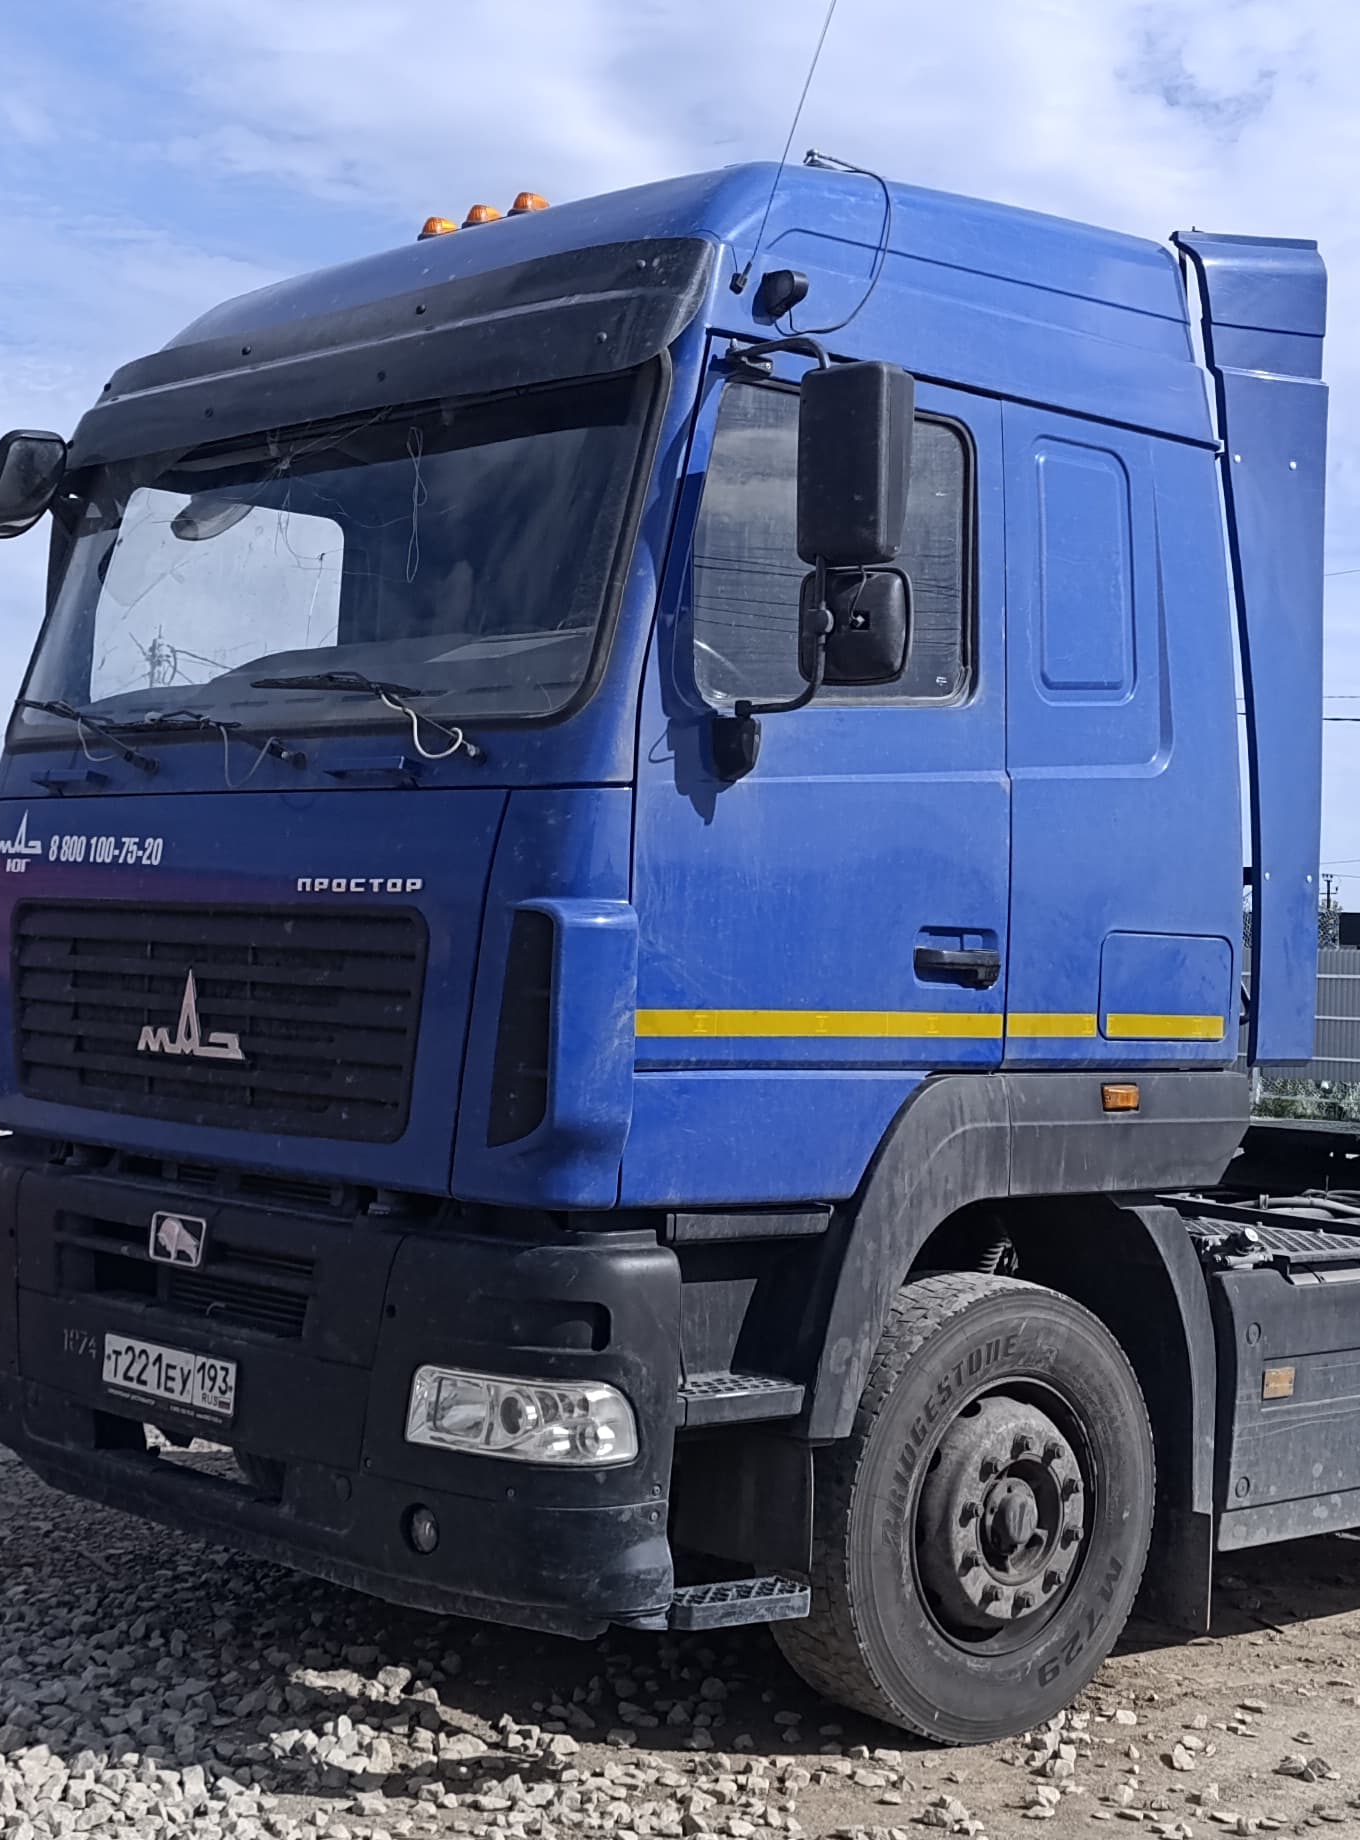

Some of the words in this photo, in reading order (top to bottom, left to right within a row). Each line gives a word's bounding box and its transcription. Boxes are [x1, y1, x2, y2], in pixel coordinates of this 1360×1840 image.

[49, 835, 60, 862] 8
[60, 835, 87, 863] 800
[89, 836, 164, 866] 100-75-20
[6, 858, 32, 873] ЮГ
[297, 878, 424, 893] ПРОСТОР
[137, 968, 246, 1060] МАЗ
[112, 1345, 192, 1396] Т221ЕУ
[196, 1361, 230, 1396] 193
[201, 1393, 218, 1406] RUS
